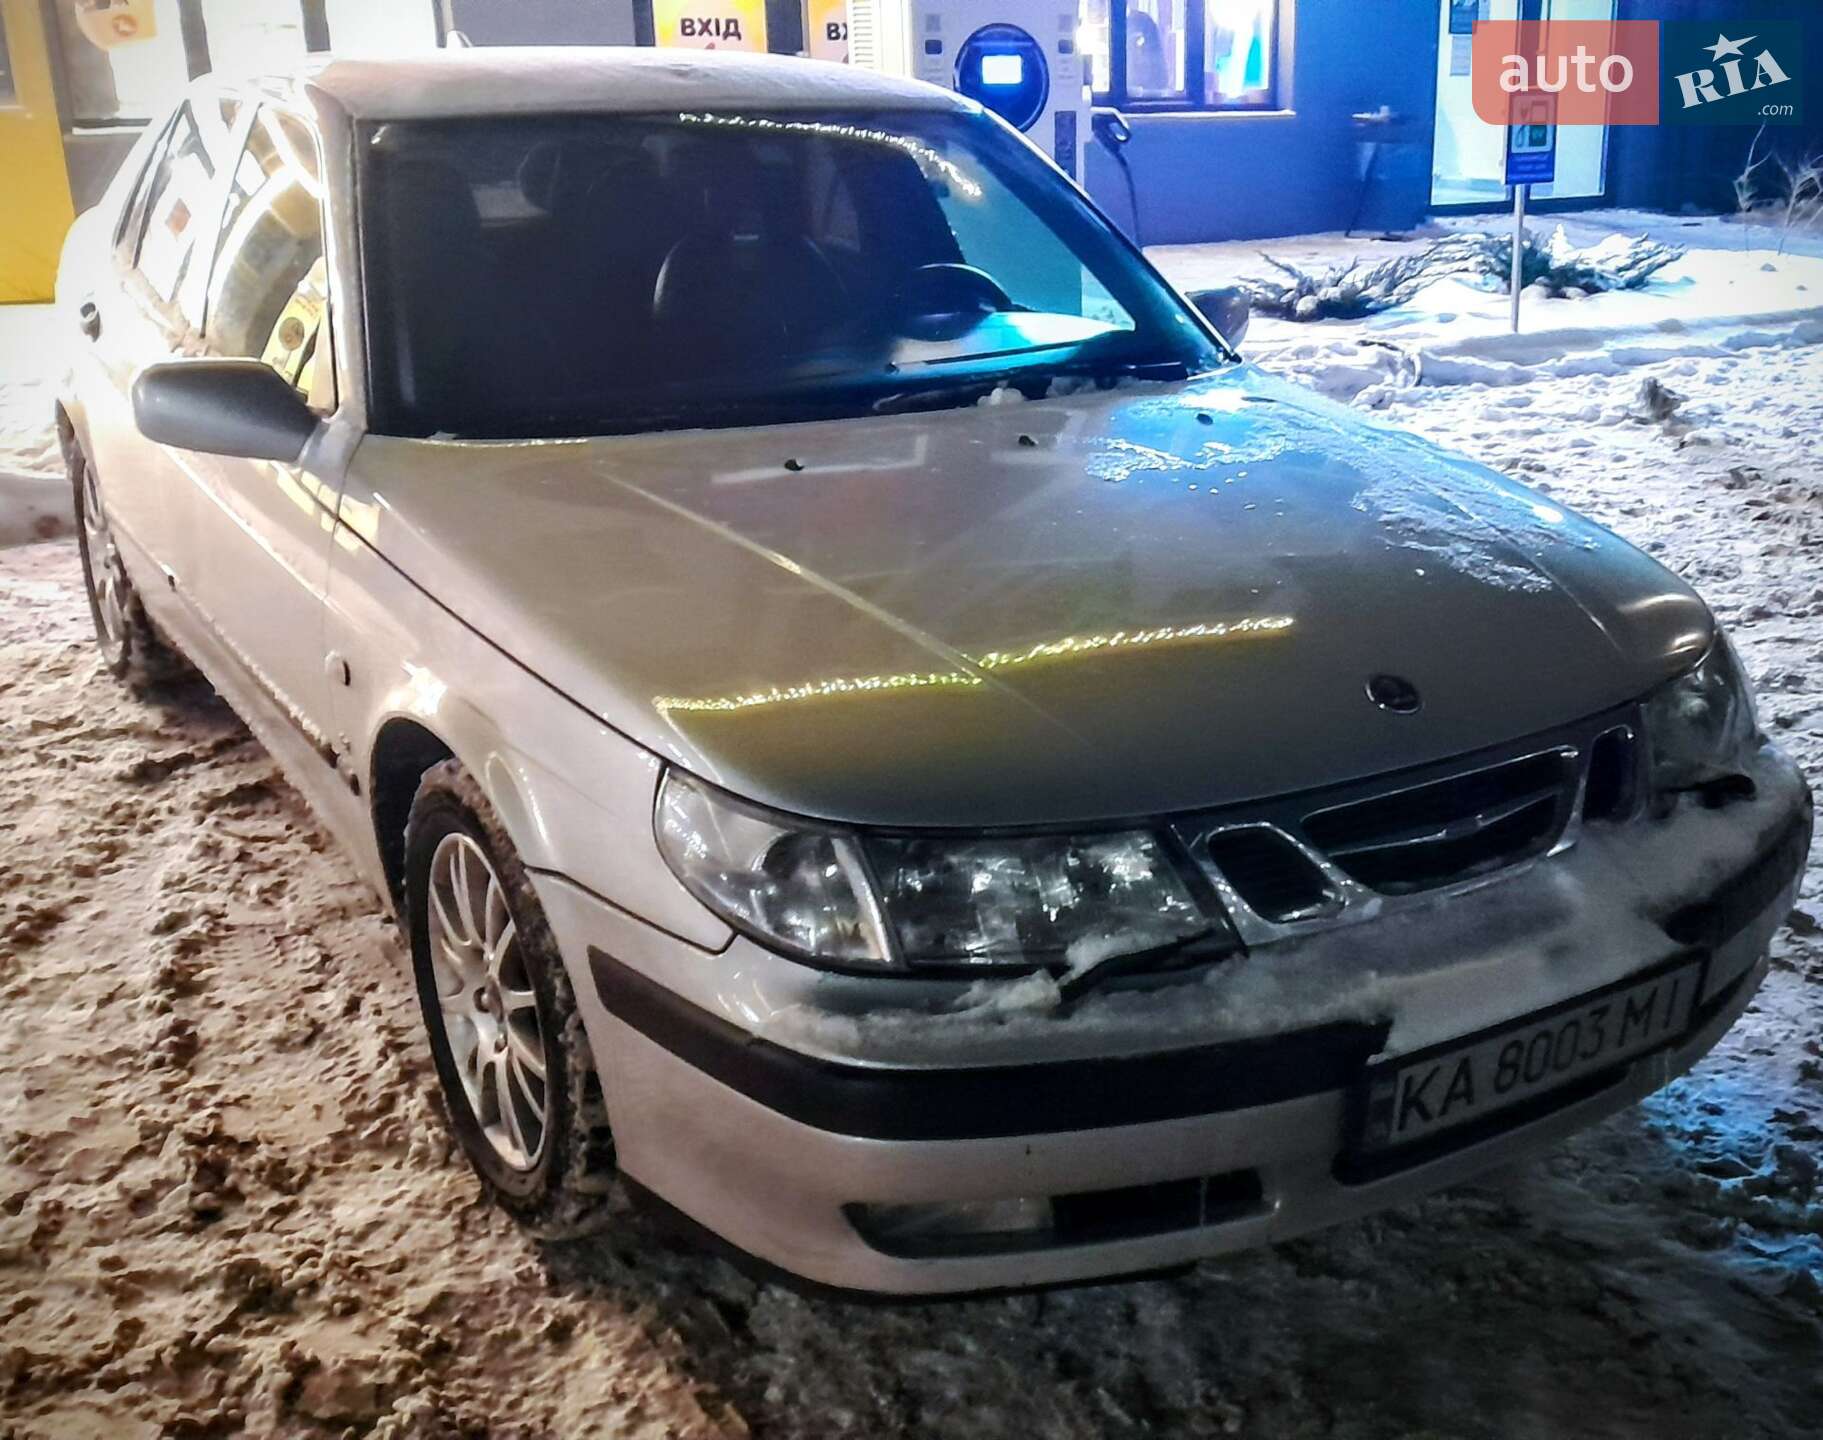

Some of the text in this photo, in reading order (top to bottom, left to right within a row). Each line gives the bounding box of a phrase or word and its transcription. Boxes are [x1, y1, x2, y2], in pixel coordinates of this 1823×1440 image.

[680, 18, 742, 40] ВХІД
[1398, 1056, 1475, 1132] KA
[1494, 1008, 1609, 1093] 8003
